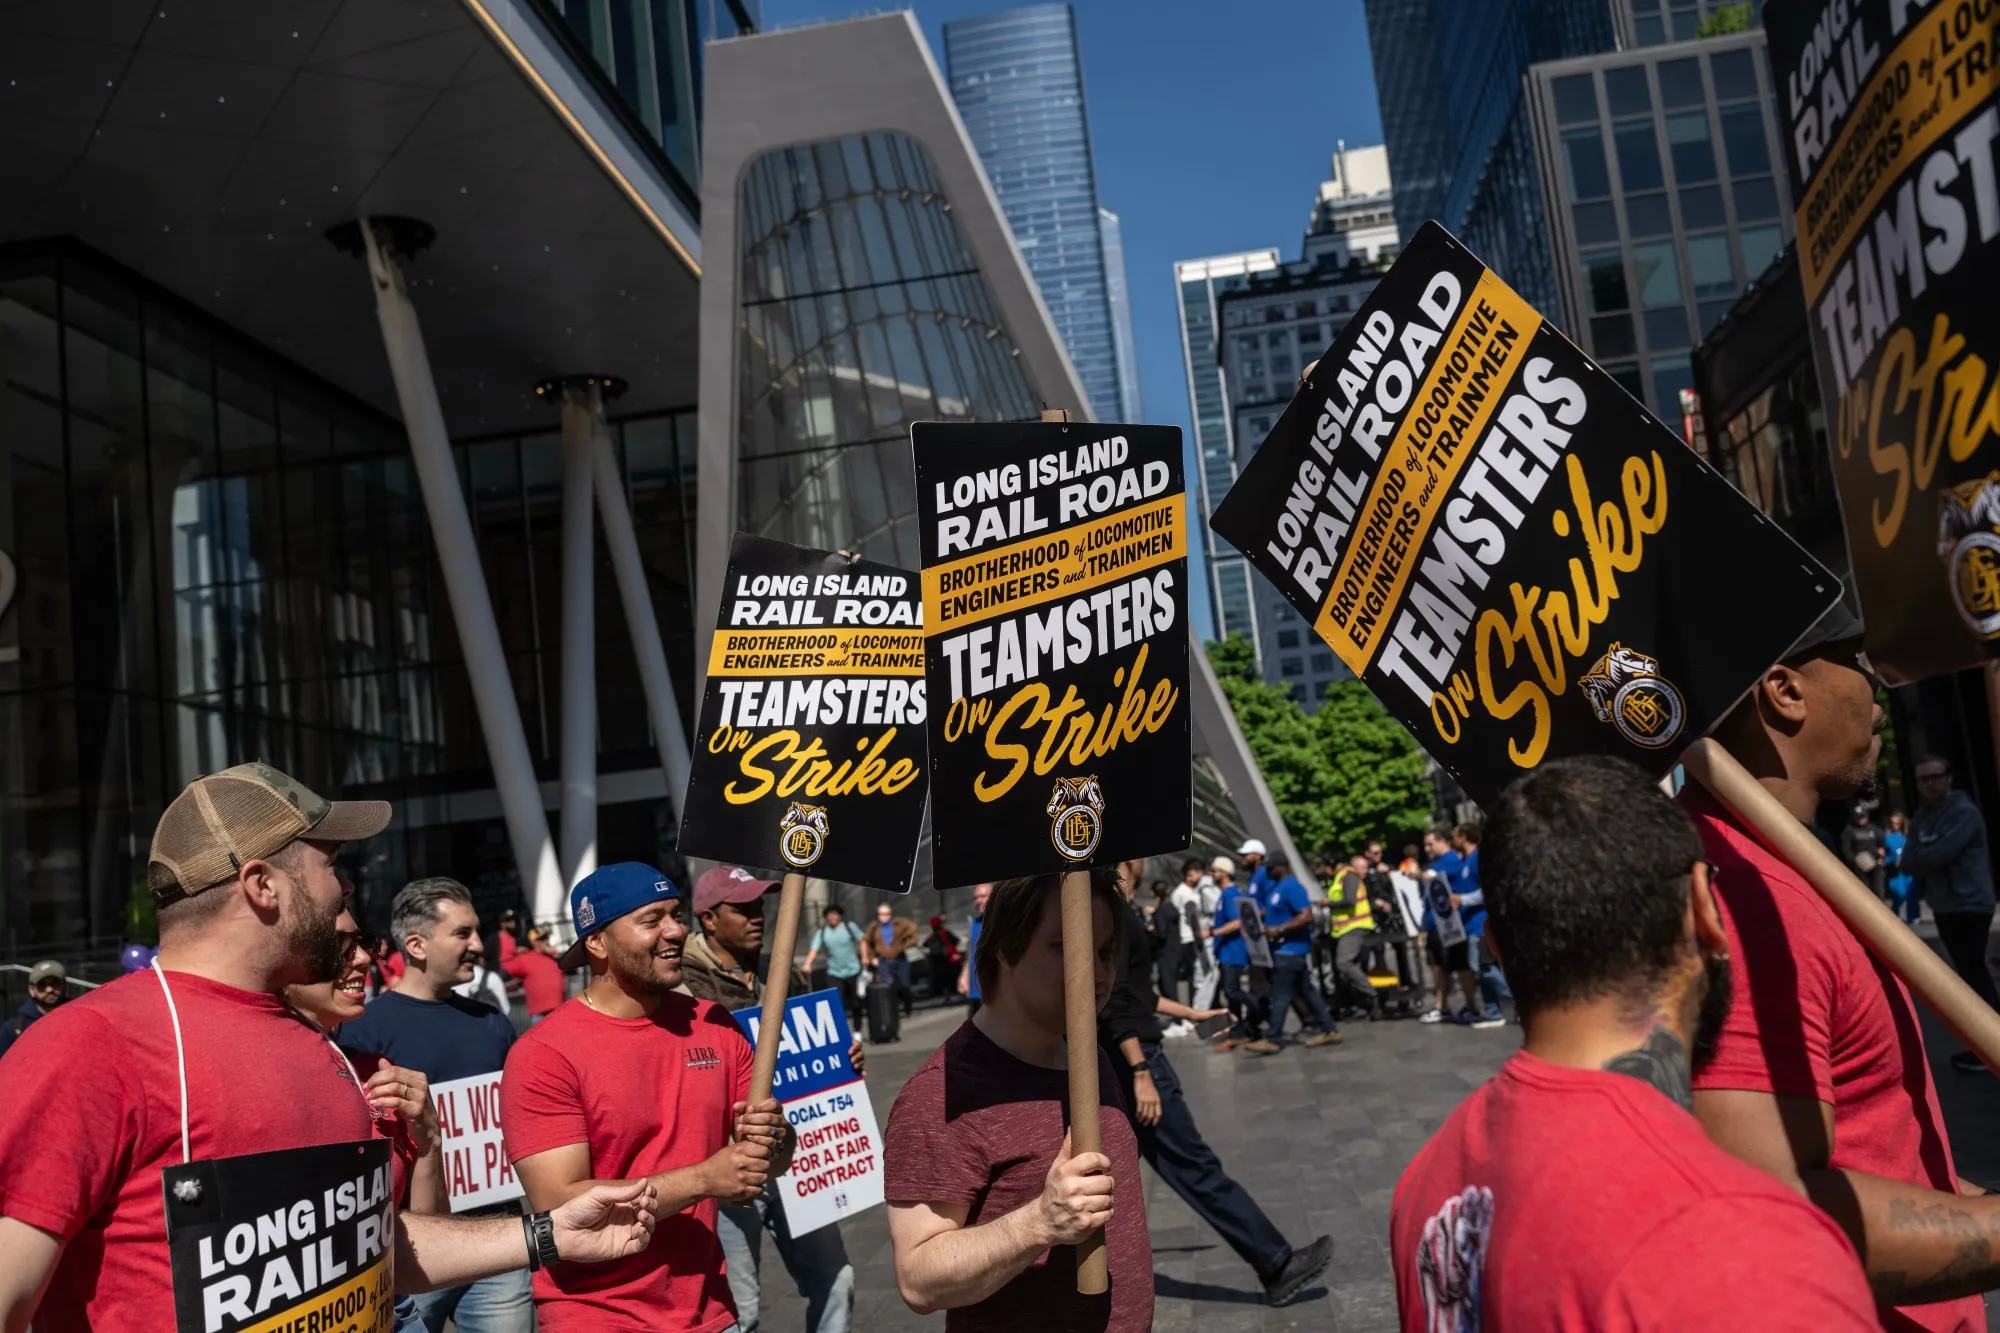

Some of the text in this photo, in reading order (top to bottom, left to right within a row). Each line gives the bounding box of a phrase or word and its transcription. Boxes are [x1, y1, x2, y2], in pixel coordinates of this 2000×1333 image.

[1788, 0, 1849, 121] LONG
[1794, 18, 1880, 184] RAIL
[1267, 310, 1395, 571] LONG ISLAND
[1292, 270, 1462, 603] RAIL ROAD
[1330, 298, 1498, 630] BROTHERHOOD of LOCOMOTIVE
[1868, 312, 2000, 549] Str
[935, 435, 1129, 514] LONG ISLAND
[937, 460, 1170, 558] RAIL ROAD
[1348, 318, 1520, 651] ENGINEERS and TRAINMEN
[939, 505, 1173, 595] BROTHERHOOD of LOCOMOTIVE
[1377, 357, 1588, 708] TEAMSTERS
[730, 600, 824, 626] RAIL
[736, 575, 907, 597] LONG ISLAND
[940, 530, 1173, 622] ENGINEERS and TRAINMEN
[1475, 449, 1668, 769] Strike
[723, 653, 925, 669] ENGINEERS and TRAINME
[727, 634, 926, 653] BROTHERHOOD of LOCOMOTI
[942, 569, 1175, 703] TEAMSTERS
[708, 724, 754, 754] On
[719, 679, 927, 728] TEAMSTERS
[944, 696, 992, 742] On
[974, 643, 1179, 803] Strike
[1431, 669, 1475, 744] On
[724, 726, 920, 805] Strike
[687, 1047, 717, 1061] LIRR
[773, 1054, 842, 1086] UNION
[789, 1093, 855, 1126] OCAL 754
[796, 1117, 861, 1152] IGHTING
[791, 1135, 871, 1177] FOR A FAIR
[796, 1155, 876, 1198] CONTRACT
[199, 1199, 316, 1279] LONG
[203, 1235, 347, 1333] RAIL
